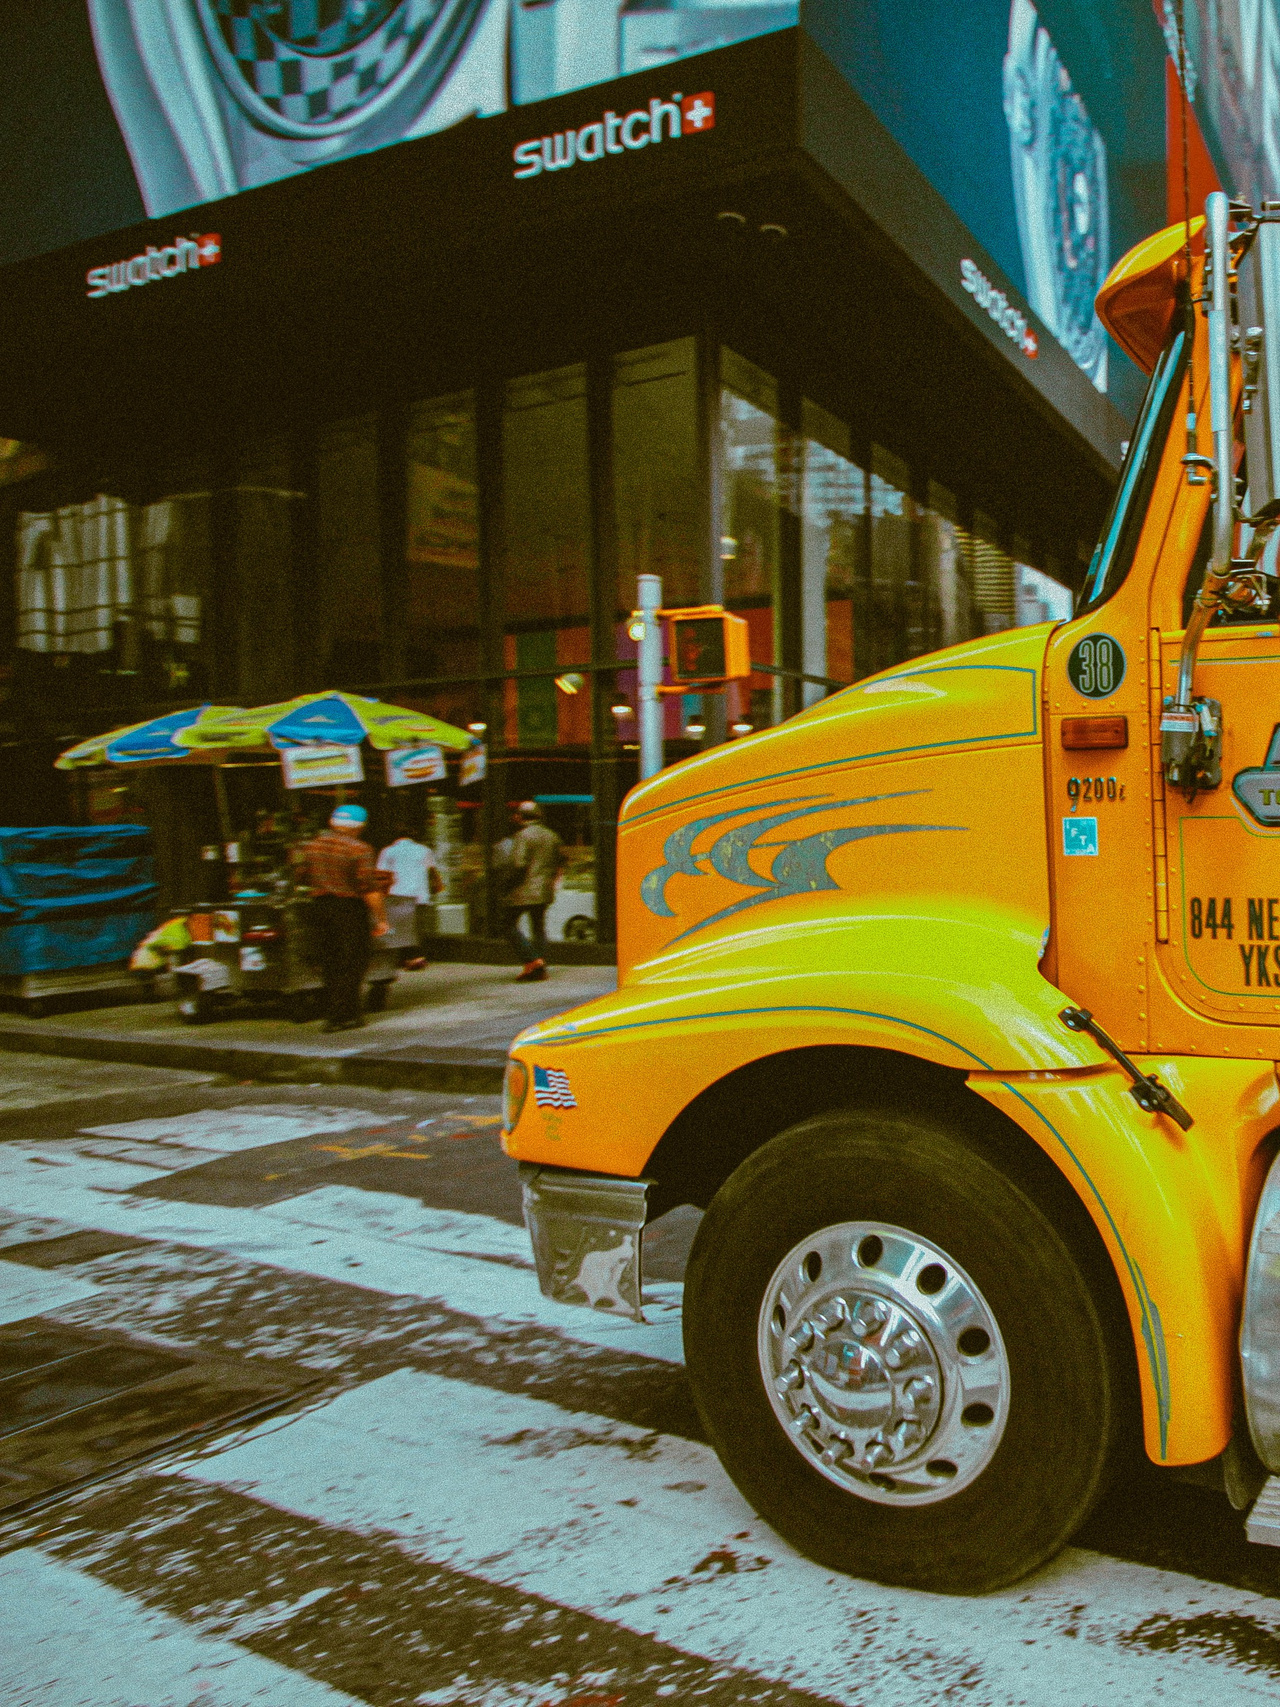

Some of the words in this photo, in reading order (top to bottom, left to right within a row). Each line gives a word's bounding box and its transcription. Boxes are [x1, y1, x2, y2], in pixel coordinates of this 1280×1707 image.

[513, 96, 682, 178] swatch
[85, 236, 200, 298] swatch
[1078, 638, 1114, 693] 38
[1189, 896, 1235, 940] 844
